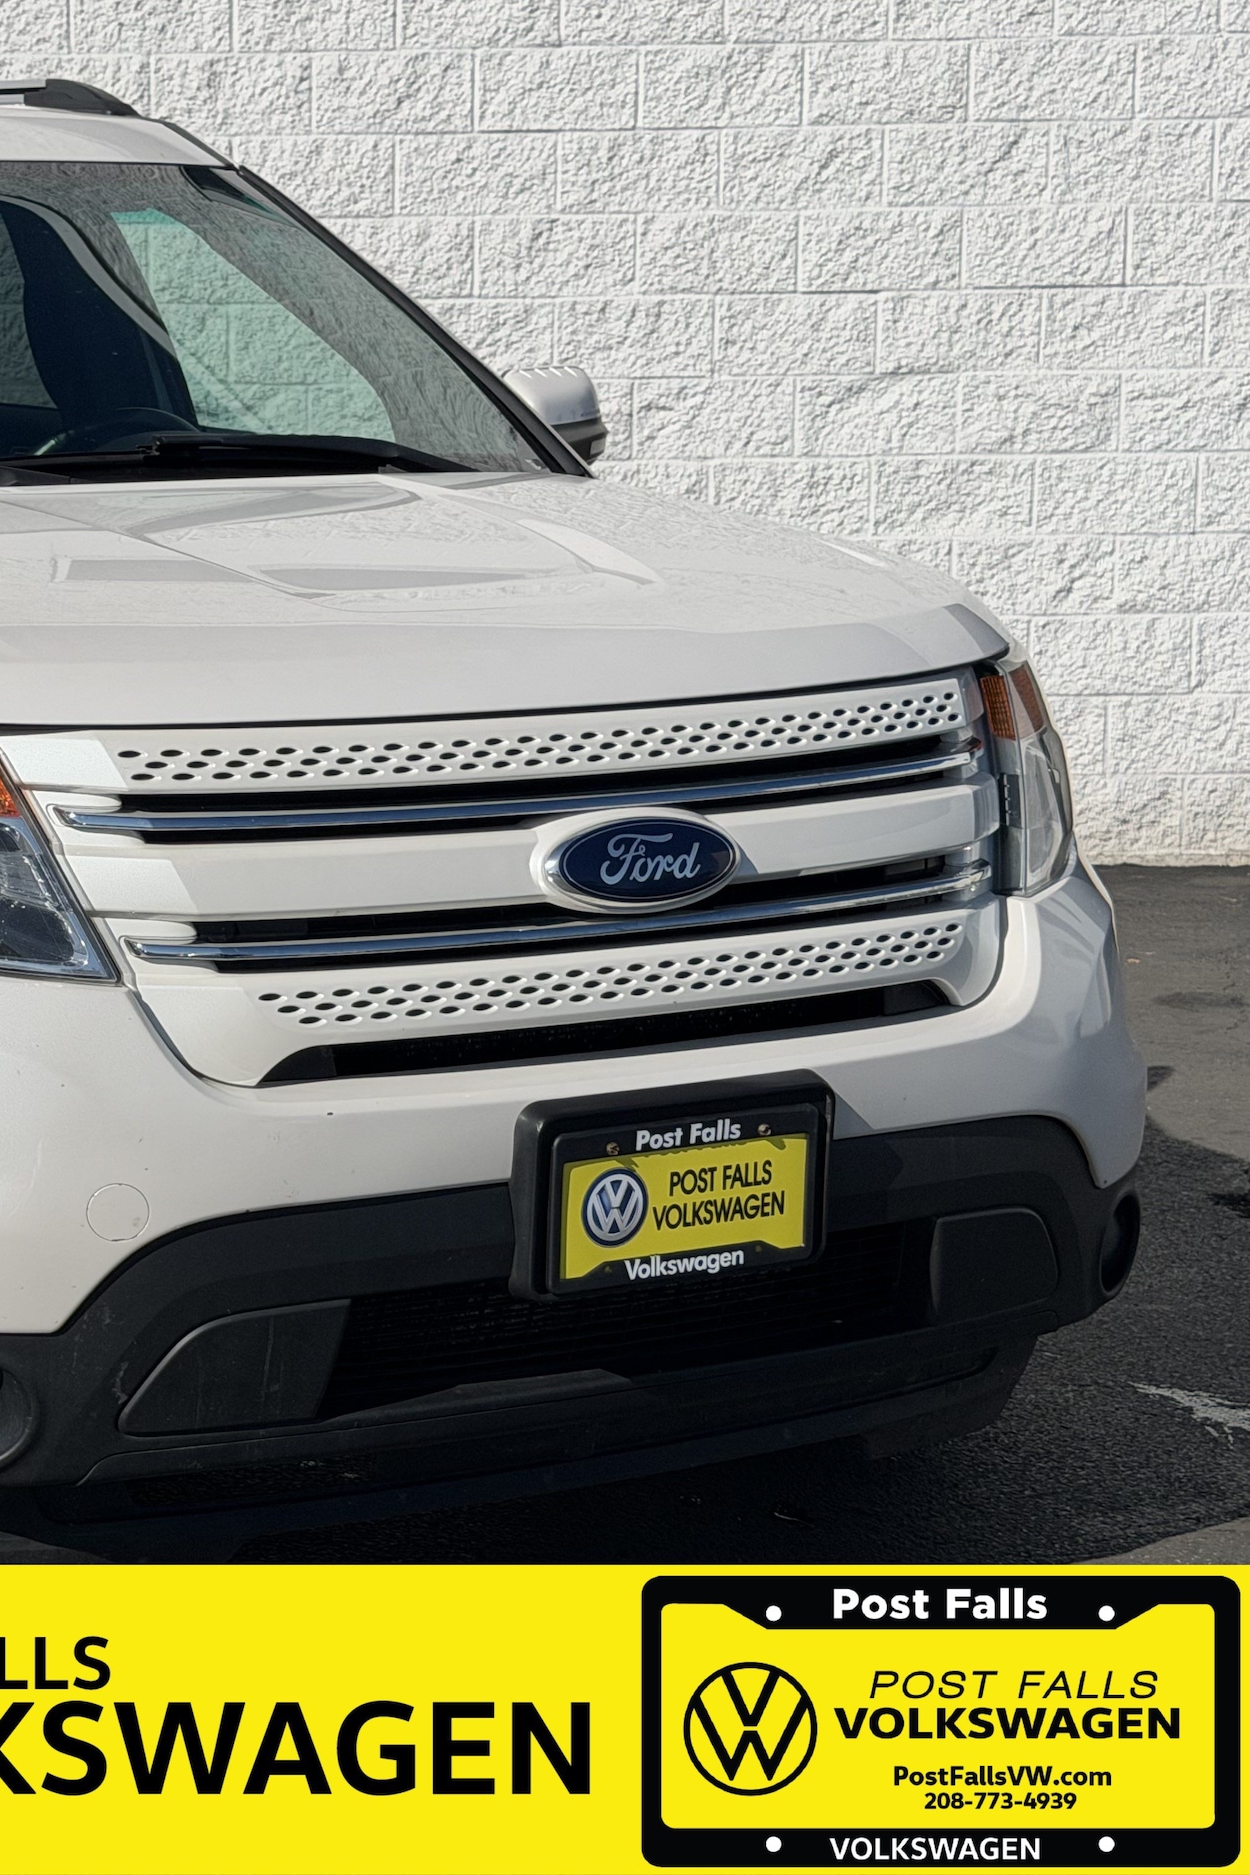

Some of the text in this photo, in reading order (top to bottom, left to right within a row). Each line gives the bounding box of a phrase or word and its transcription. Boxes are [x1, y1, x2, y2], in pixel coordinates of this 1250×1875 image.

[600, 832, 701, 885] Ford
[636, 1118, 742, 1151] Post Falls
[669, 1160, 772, 1198] POST FALLS
[653, 1191, 785, 1231] VOLKSWAGEN
[624, 1250, 745, 1280] Volkswagen
